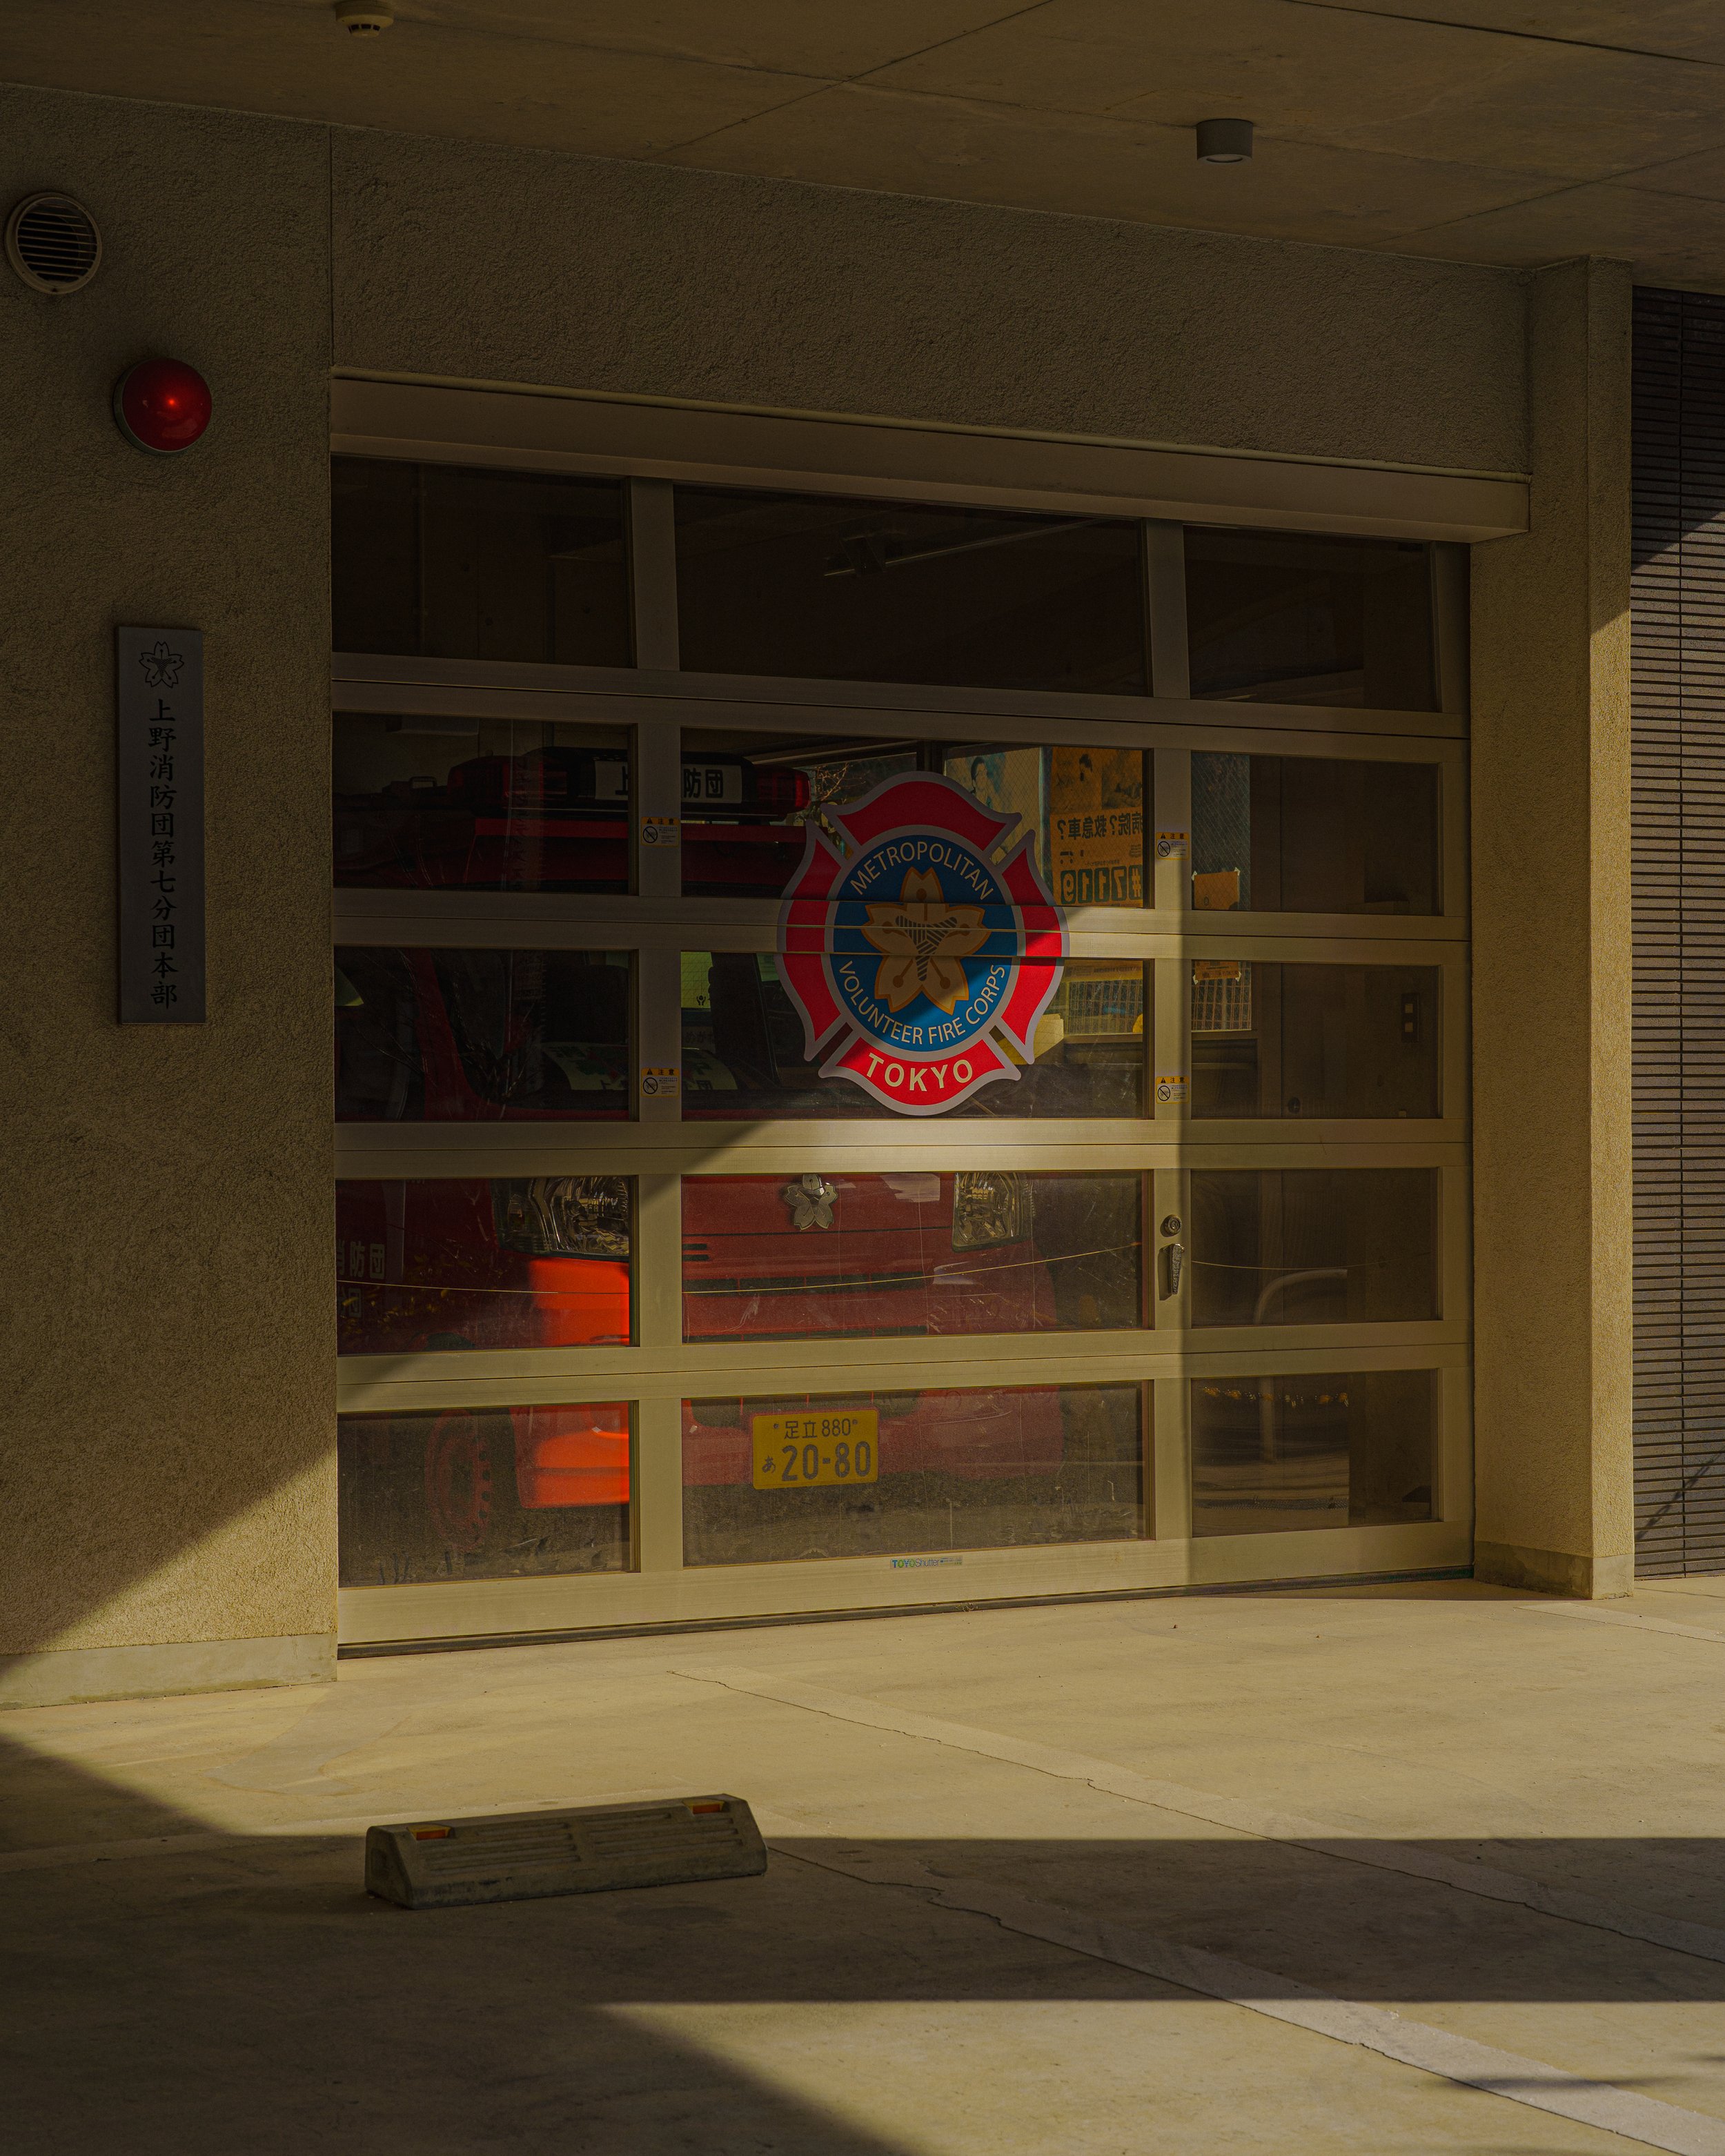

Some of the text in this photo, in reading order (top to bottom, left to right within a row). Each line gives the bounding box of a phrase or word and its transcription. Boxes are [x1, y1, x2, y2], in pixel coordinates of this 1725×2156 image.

[148, 698, 179, 1009] 上野消防団第七分団本部
[849, 840, 995, 900] METROPOLITAN
[839, 960, 1006, 1045] VOLUNTEER FIRE CORPS
[866, 1052, 974, 1091] TOKYO
[822, 1418, 851, 1437] 880
[781, 1441, 871, 1482] 20-80
